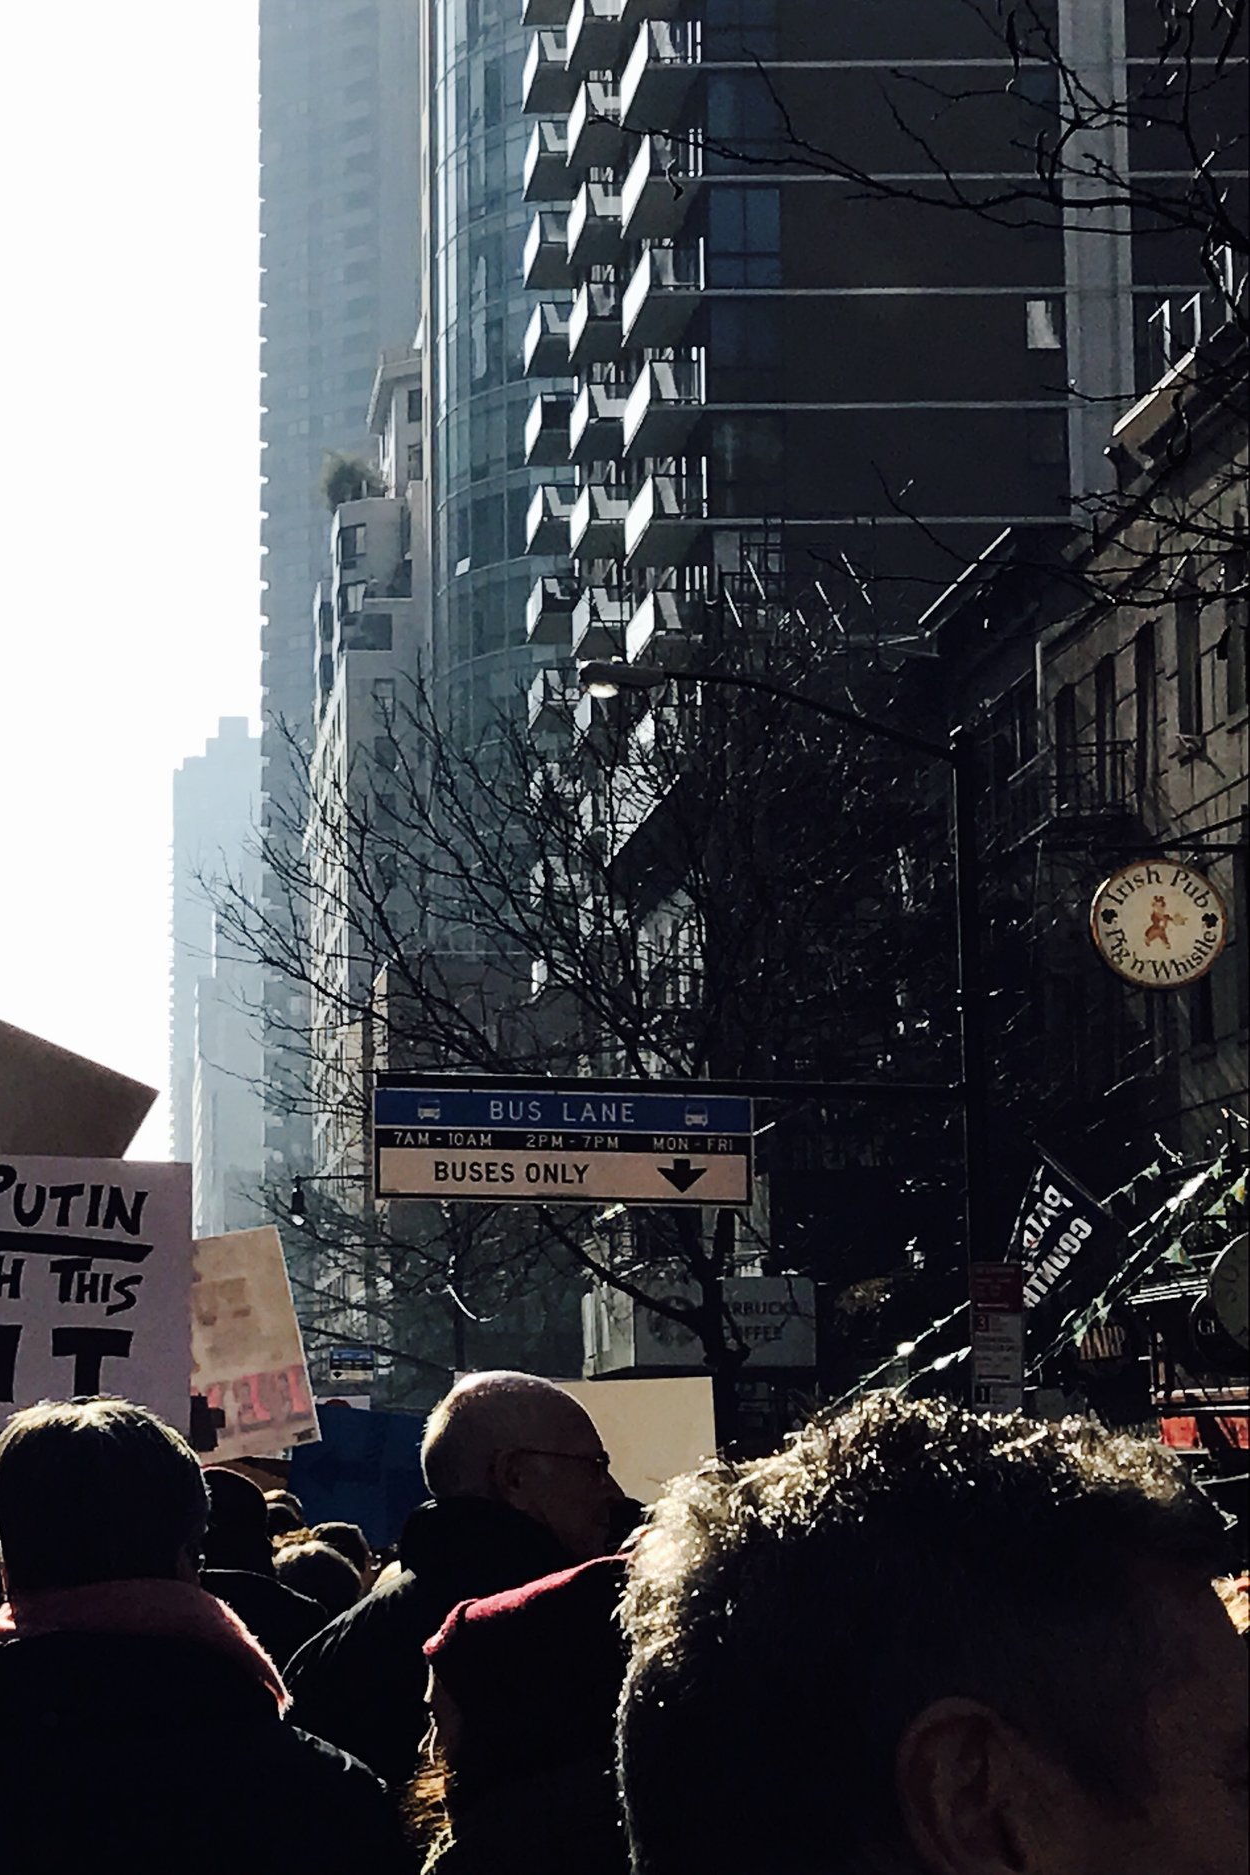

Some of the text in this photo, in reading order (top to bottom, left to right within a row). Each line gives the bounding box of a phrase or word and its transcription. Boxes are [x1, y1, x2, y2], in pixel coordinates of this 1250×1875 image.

[1105, 866, 1211, 908] Irish Pub
[1105, 928, 1130, 965] Pig
[1149, 930, 1217, 979] Whistle
[489, 1101, 635, 1124] BUS LANE
[434, 1161, 590, 1184] BUSES ONLY
[50, 1257, 144, 1316] THIS
